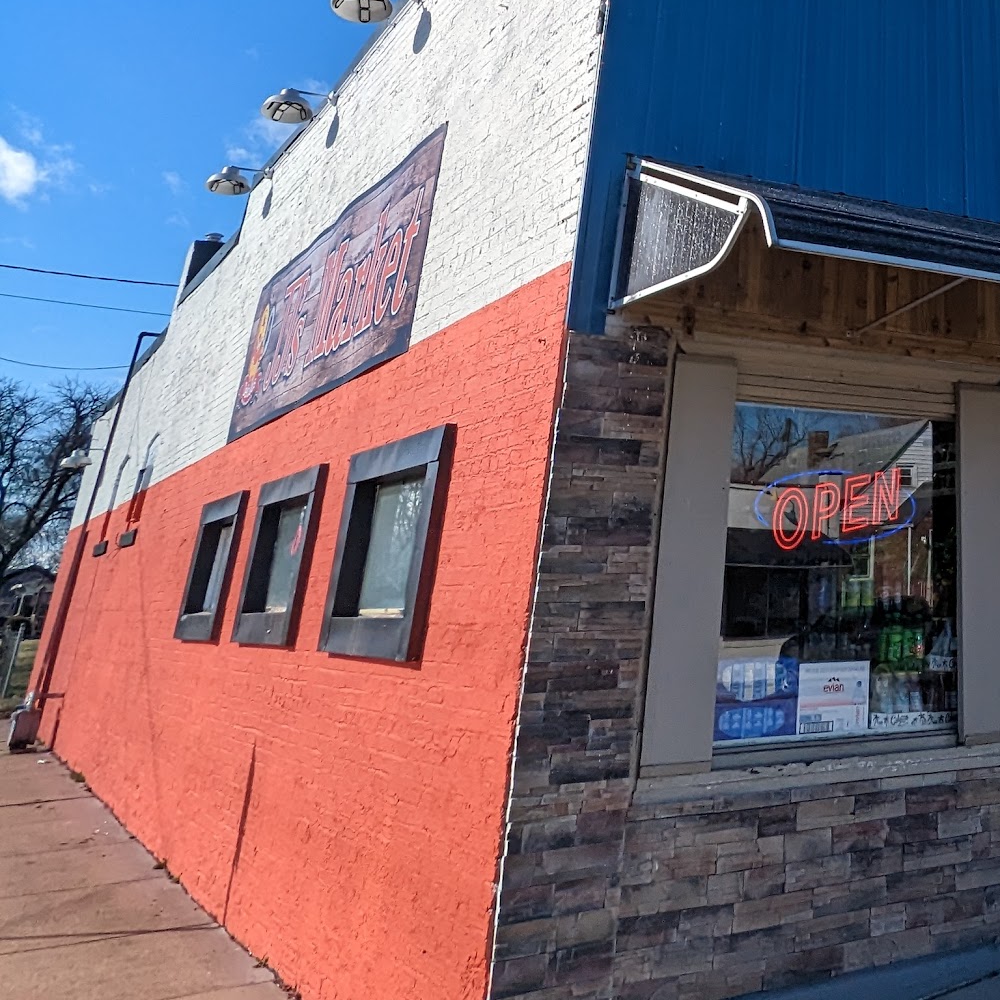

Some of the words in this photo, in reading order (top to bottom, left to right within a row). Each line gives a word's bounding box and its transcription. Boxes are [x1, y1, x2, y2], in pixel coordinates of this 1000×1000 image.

[303, 187, 425, 369] Market
[773, 467, 903, 550] OPEN
[823, 683, 845, 693] evian
